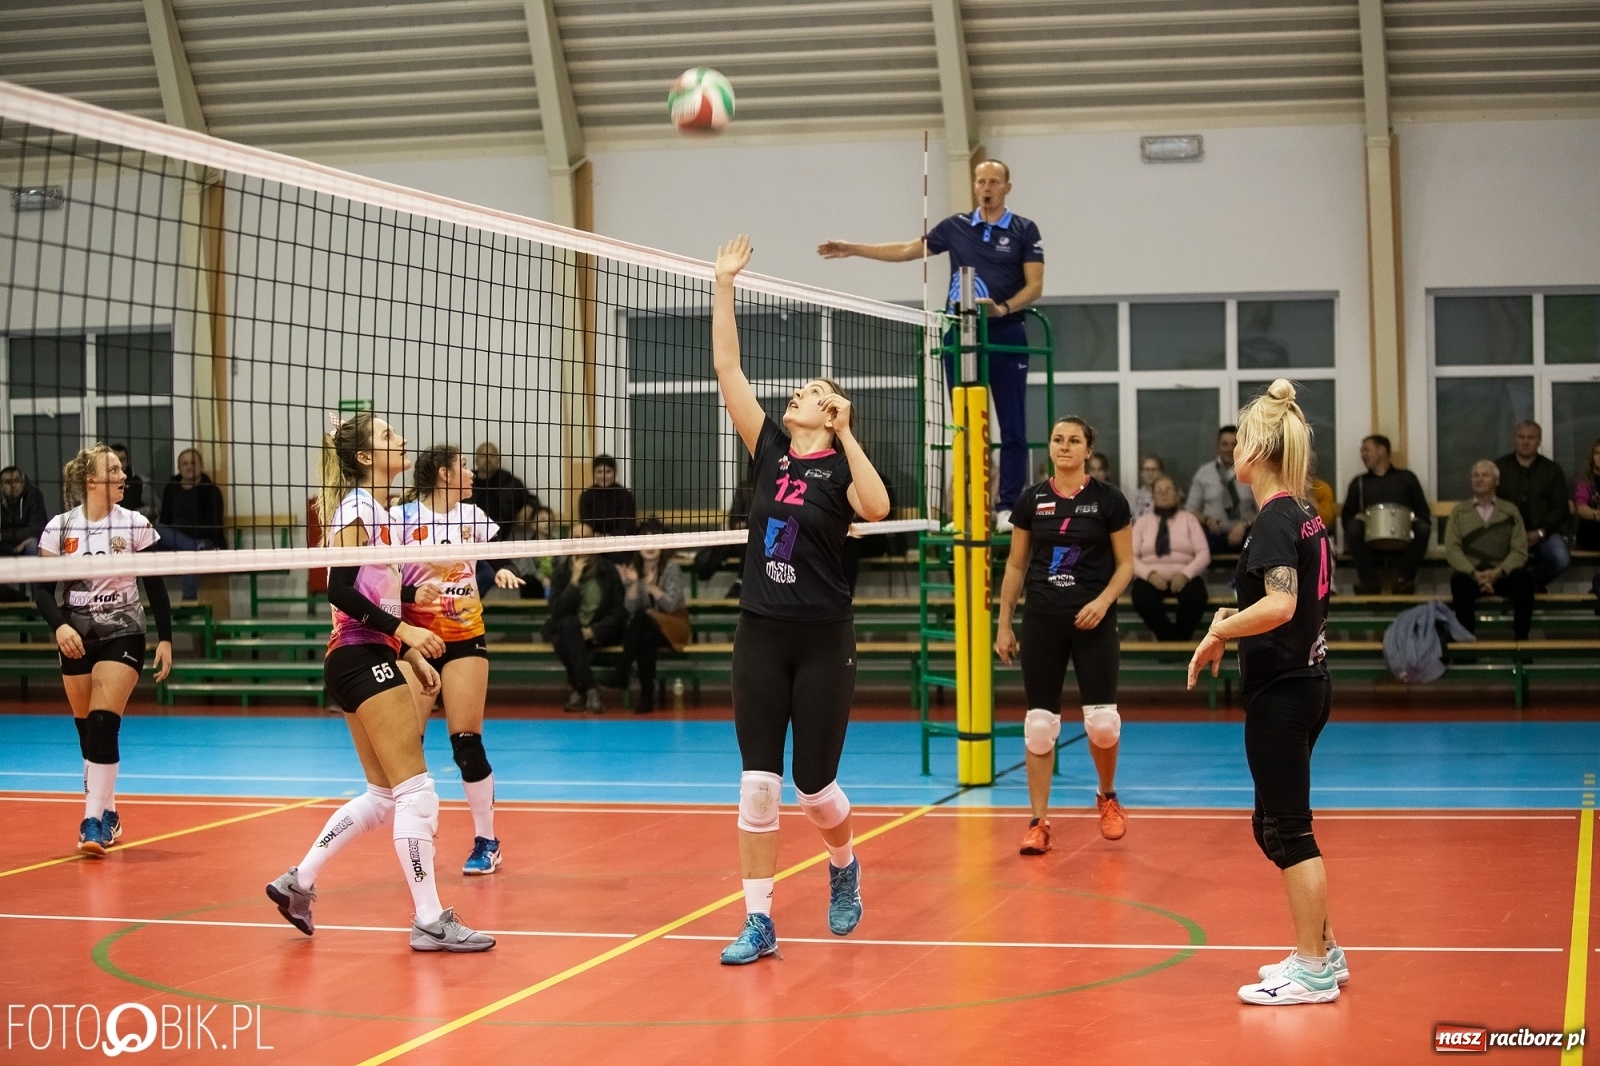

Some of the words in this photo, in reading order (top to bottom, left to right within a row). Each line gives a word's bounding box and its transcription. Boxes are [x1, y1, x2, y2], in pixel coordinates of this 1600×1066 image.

[775, 473, 807, 506] 12
[1075, 504, 1099, 513] FBS
[1317, 536, 1329, 600] 4
[371, 662, 395, 683] 55
